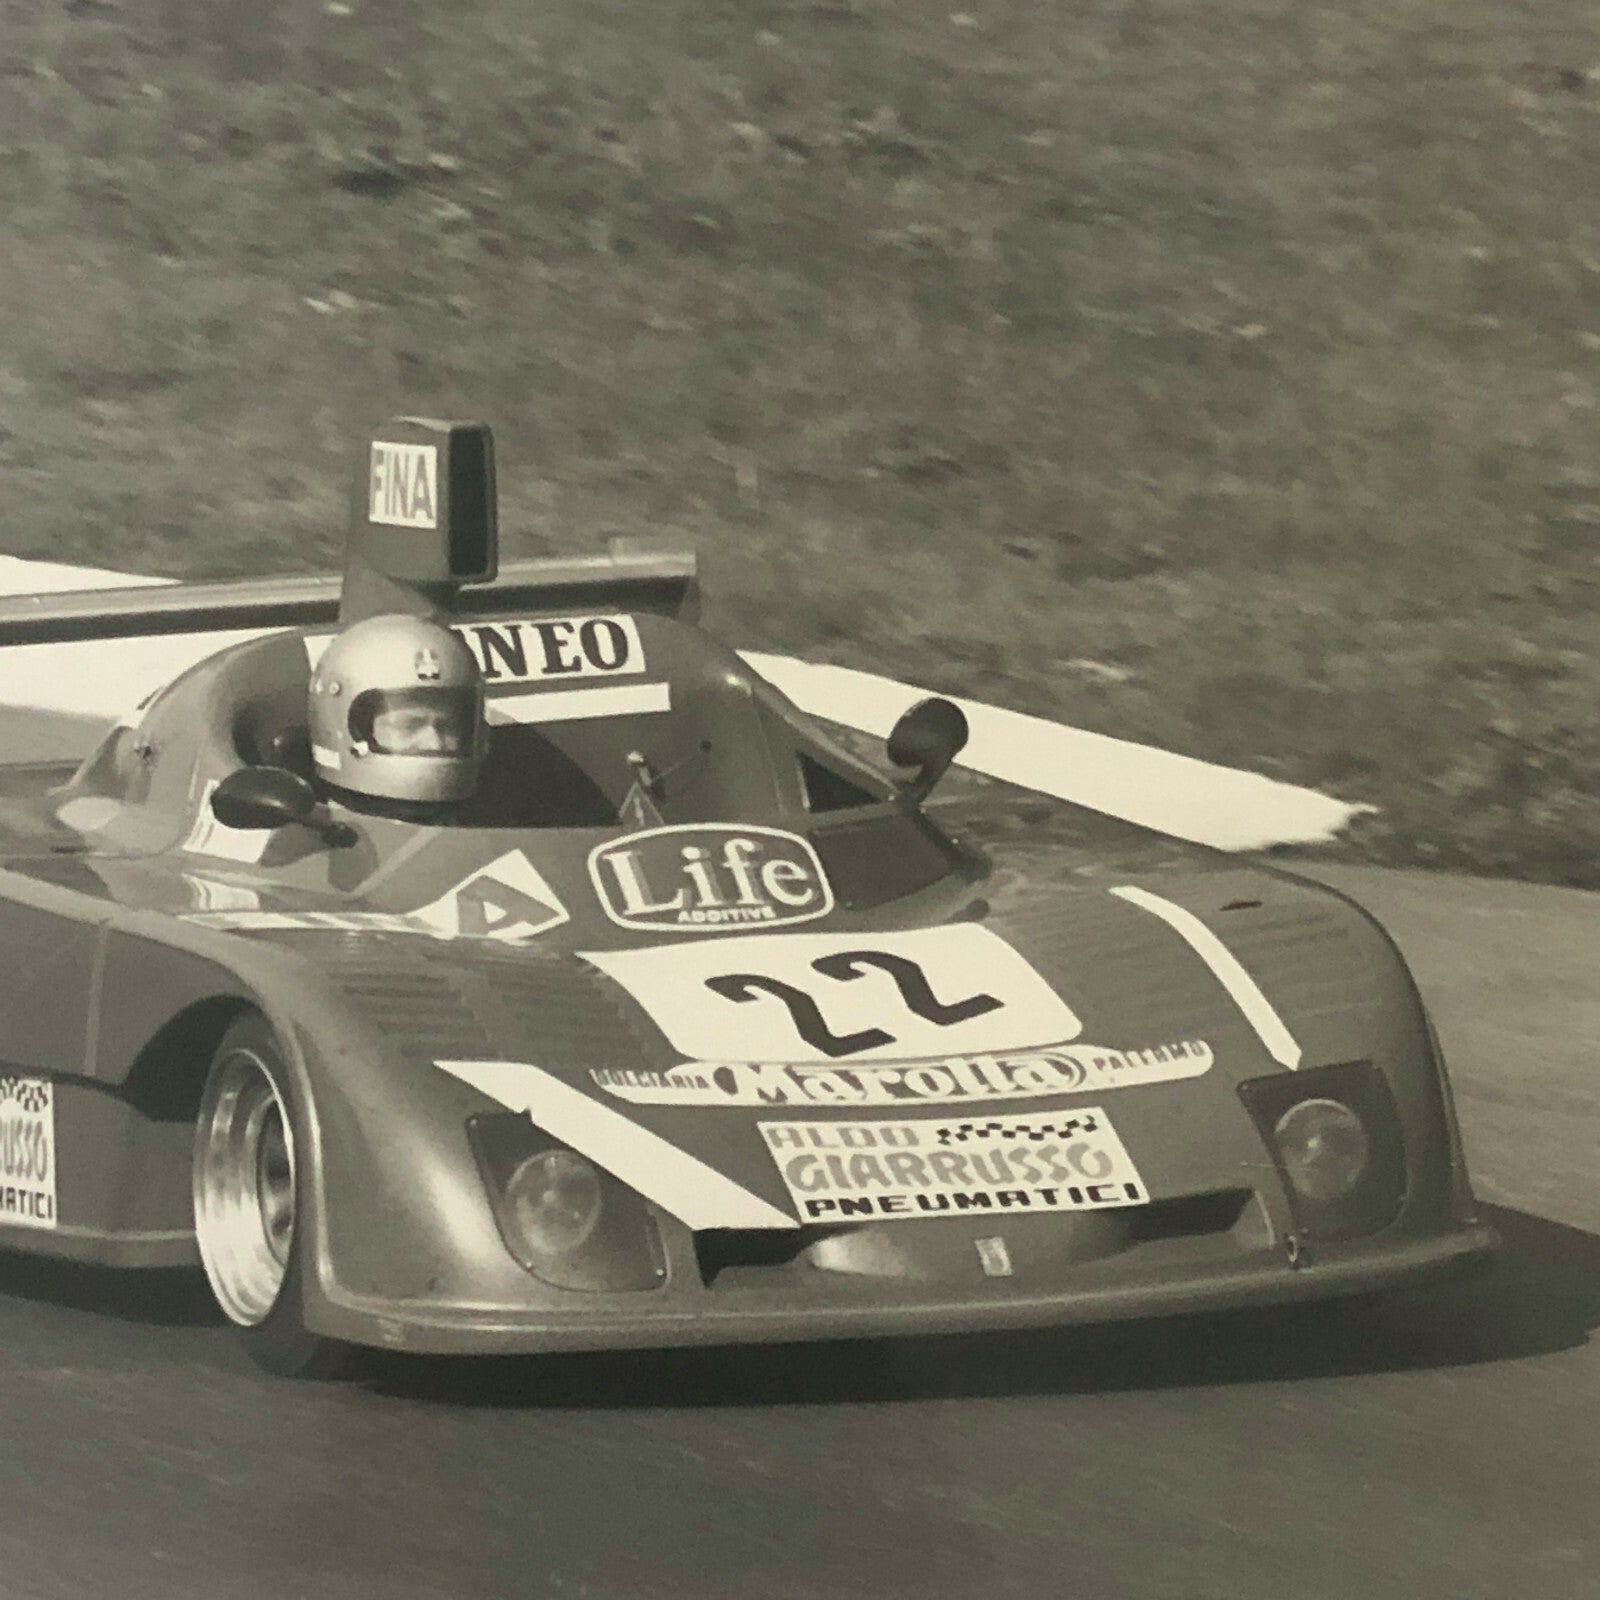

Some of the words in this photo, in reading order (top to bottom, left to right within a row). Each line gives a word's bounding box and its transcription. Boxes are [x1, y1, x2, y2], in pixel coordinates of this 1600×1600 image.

[370, 447, 434, 520] FINA
[602, 838, 817, 915] Life
[677, 904, 777, 923] ADDITIVE
[704, 950, 1005, 1058] 22
[736, 1056, 1076, 1102] Marolla
[0, 1117, 47, 1182] USSO
[766, 1126, 921, 1149] ALDO
[785, 1142, 1114, 1193] GIARRUSSO
[804, 1182, 1141, 1218] PNEUMATICI
